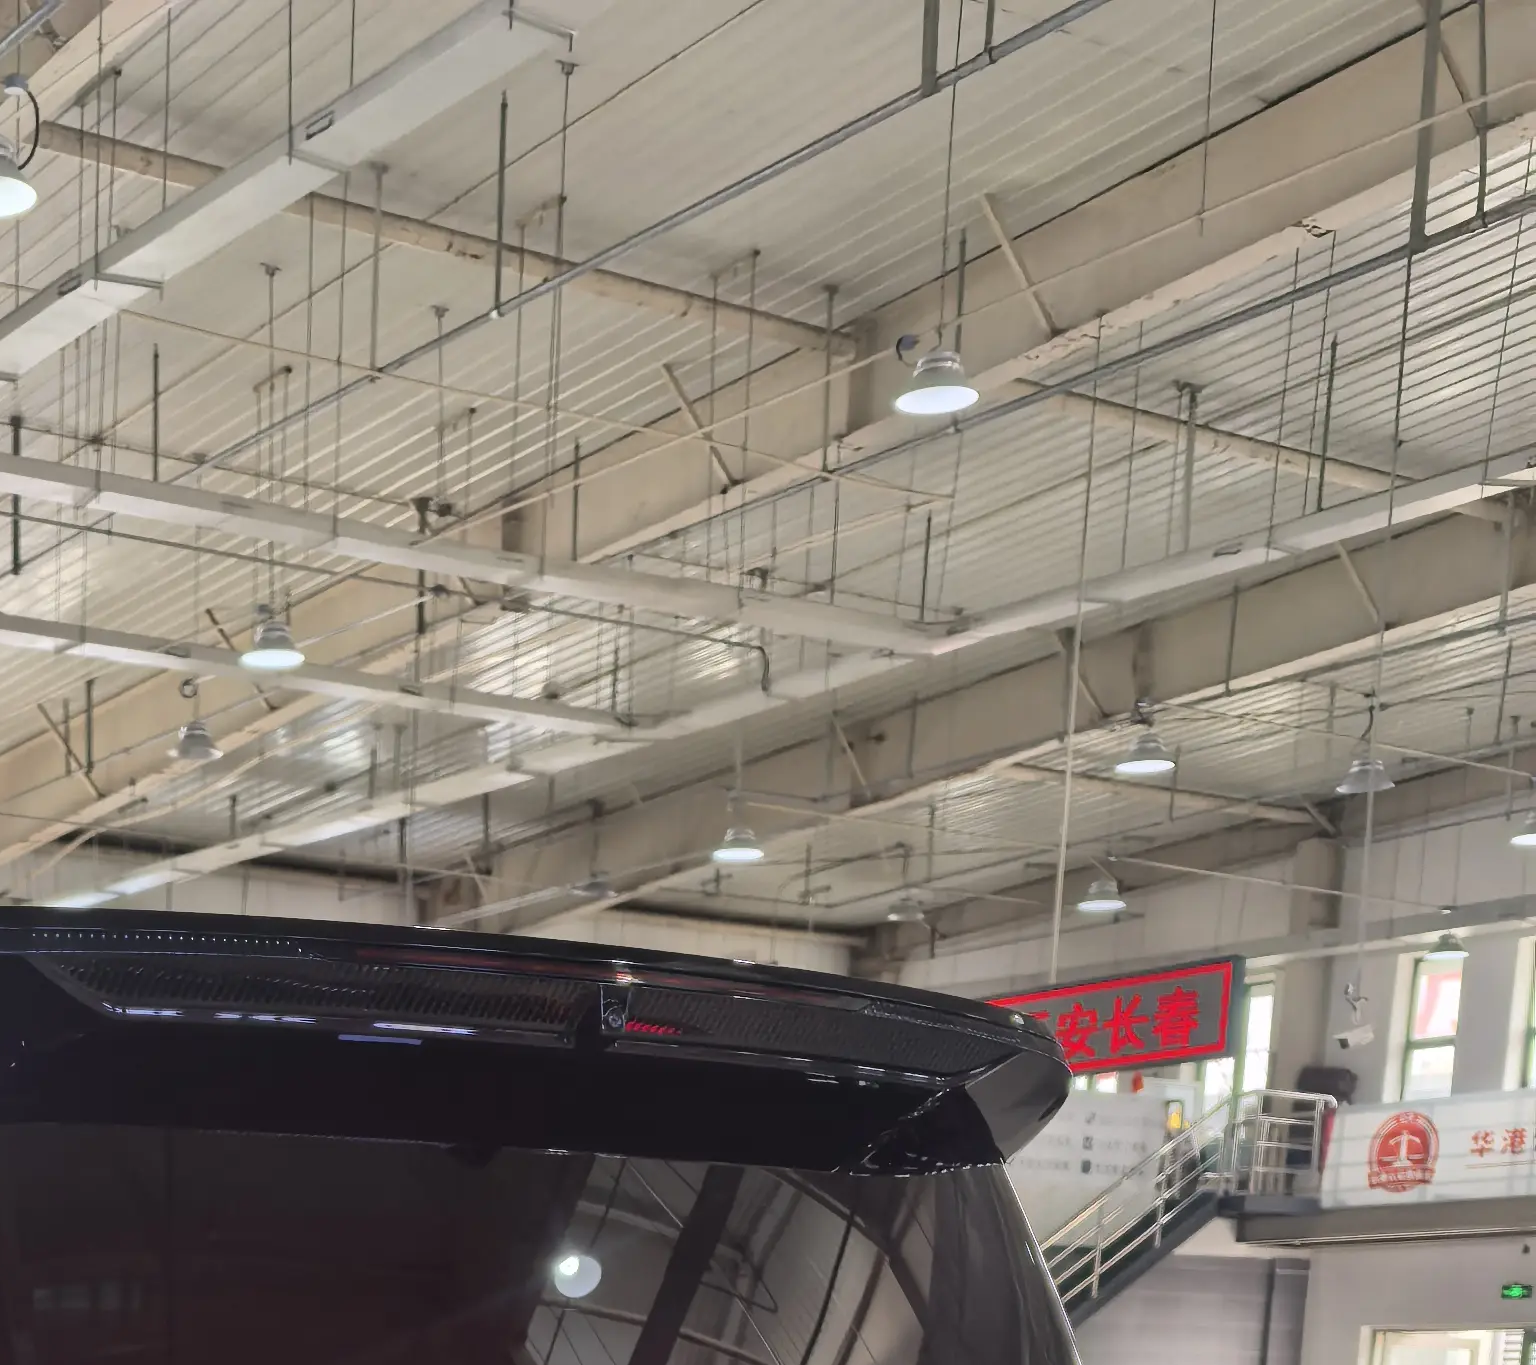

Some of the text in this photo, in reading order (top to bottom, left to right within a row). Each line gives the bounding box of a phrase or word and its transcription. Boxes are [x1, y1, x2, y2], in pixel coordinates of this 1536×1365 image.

[1033, 986, 1200, 1060] 安长春
[1470, 1127, 1527, 1158] 华港
